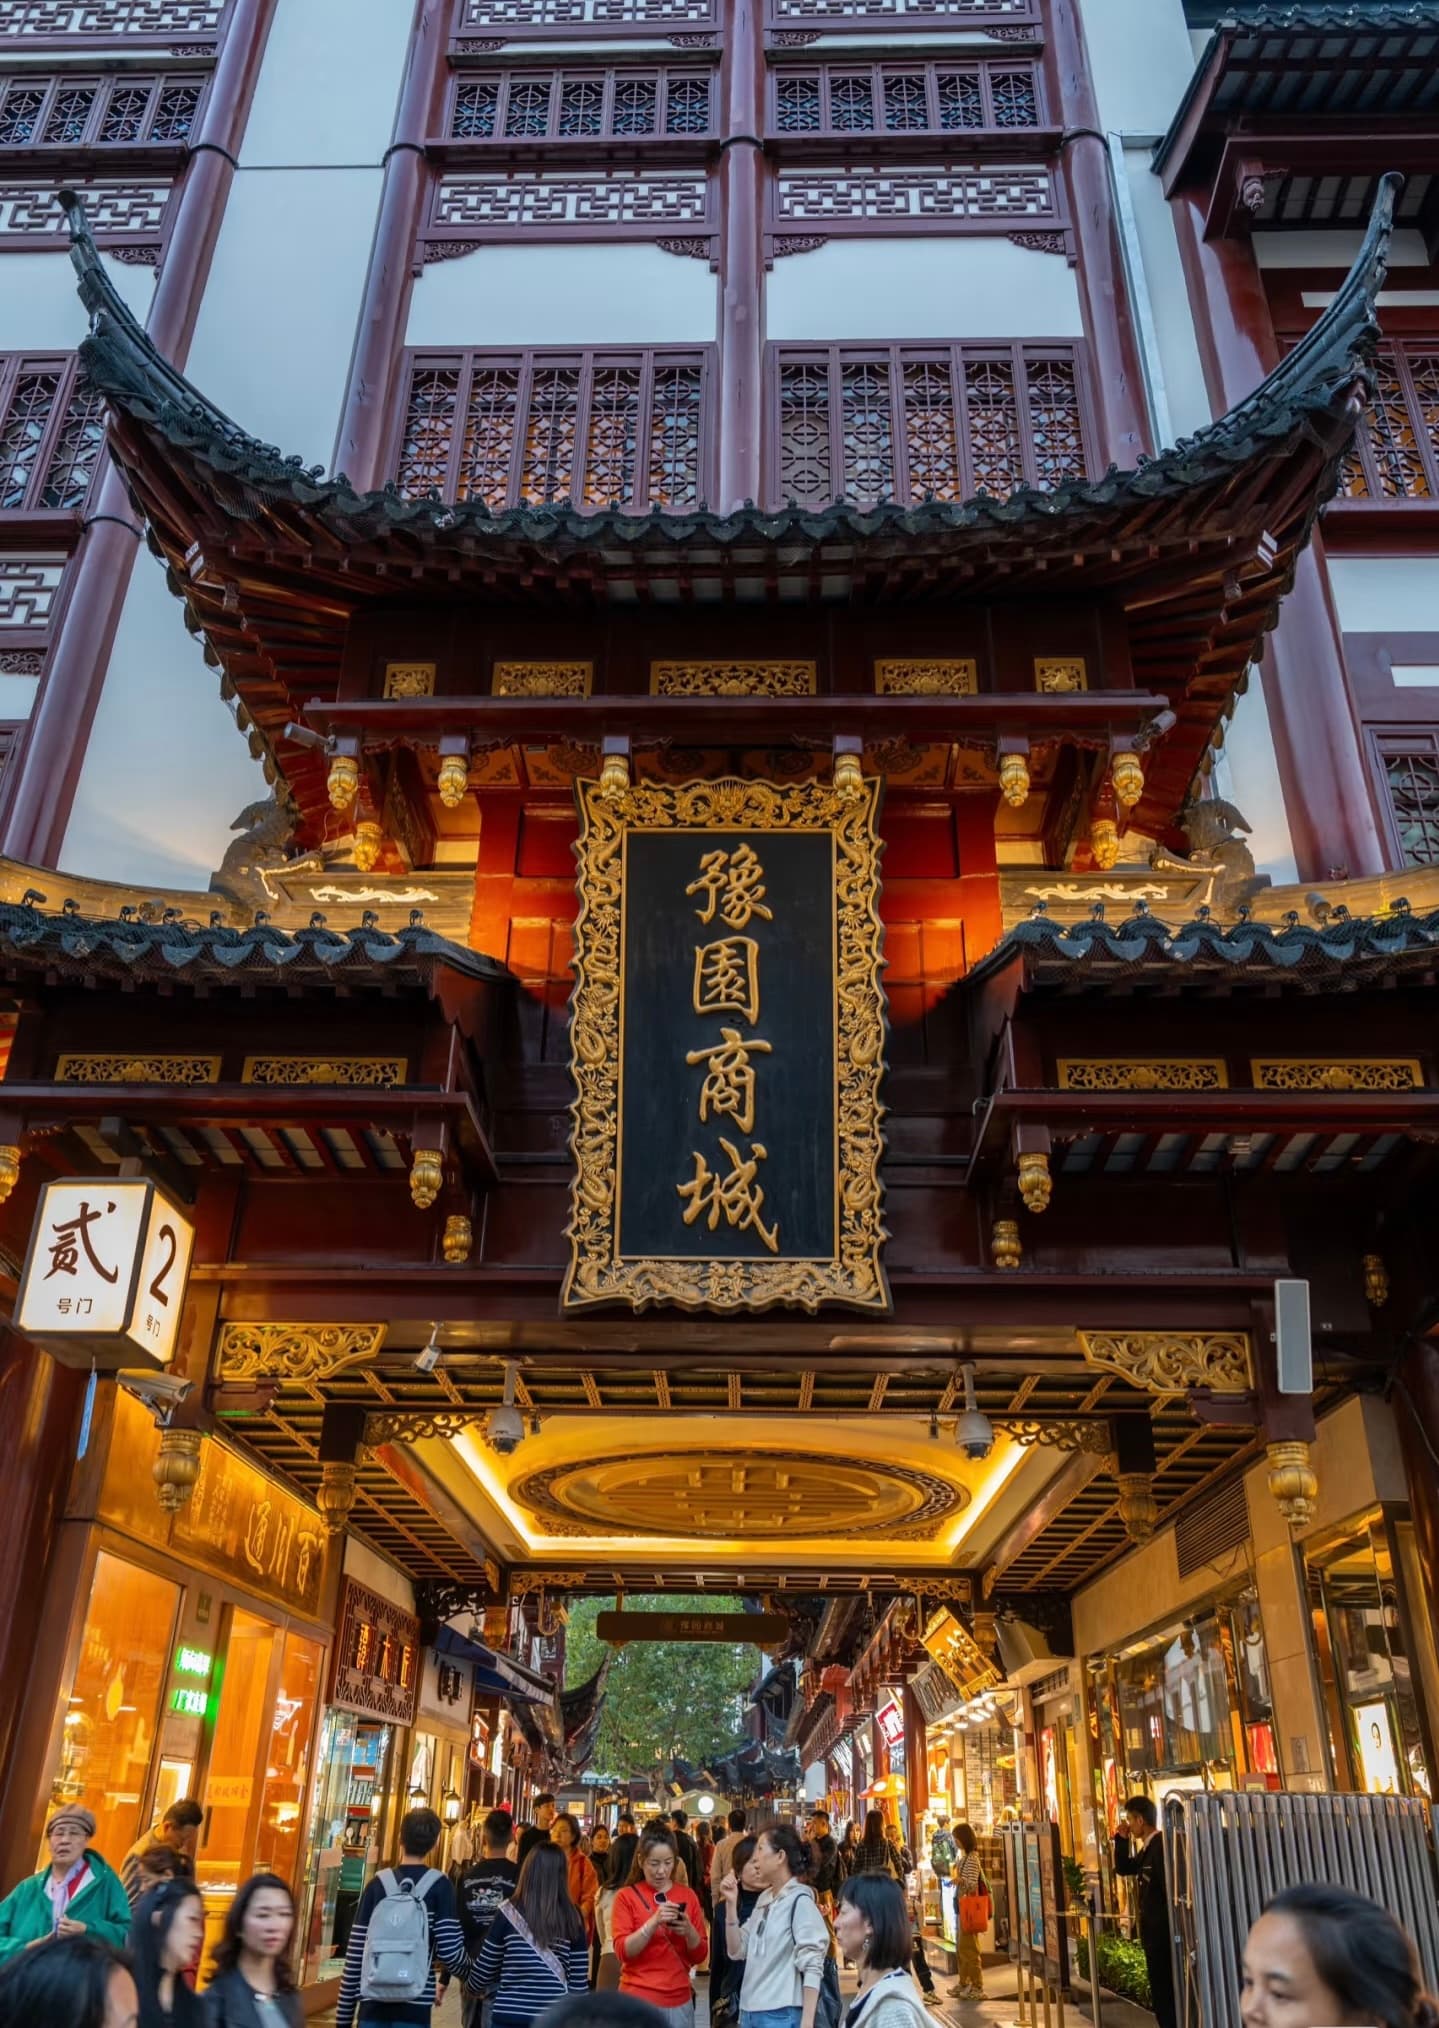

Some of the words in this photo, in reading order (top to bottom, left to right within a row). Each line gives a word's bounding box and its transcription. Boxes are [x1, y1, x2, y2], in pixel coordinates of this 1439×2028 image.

[677, 843, 779, 1254] 豫園商城
[149, 1224, 177, 1308] 2
[56, 1298, 93, 1314] 号门
[146, 1313, 161, 1337] 号门
